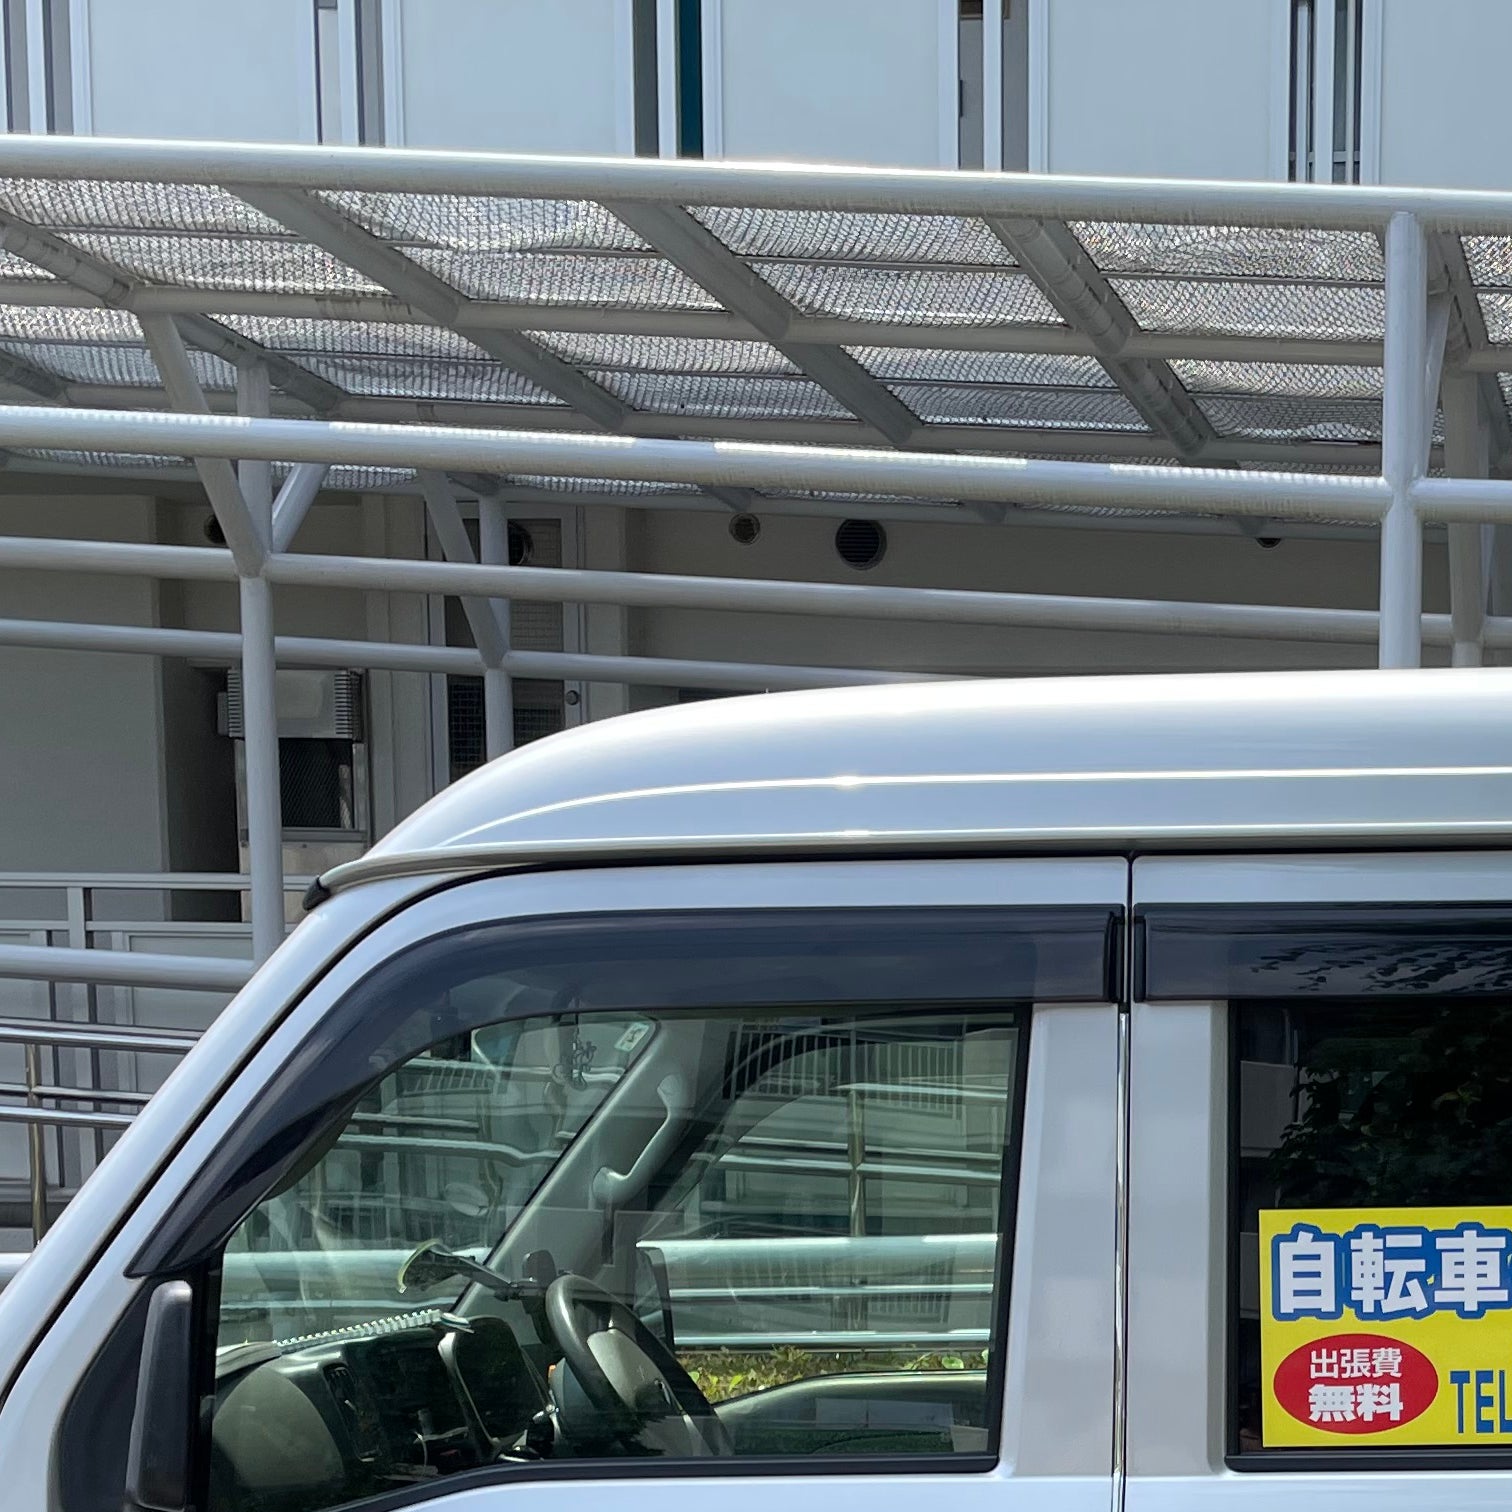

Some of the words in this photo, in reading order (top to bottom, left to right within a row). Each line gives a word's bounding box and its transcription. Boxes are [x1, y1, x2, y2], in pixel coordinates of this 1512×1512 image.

[1309, 1347, 1403, 1380] 出張費
[1308, 1383, 1403, 1423] 無料
